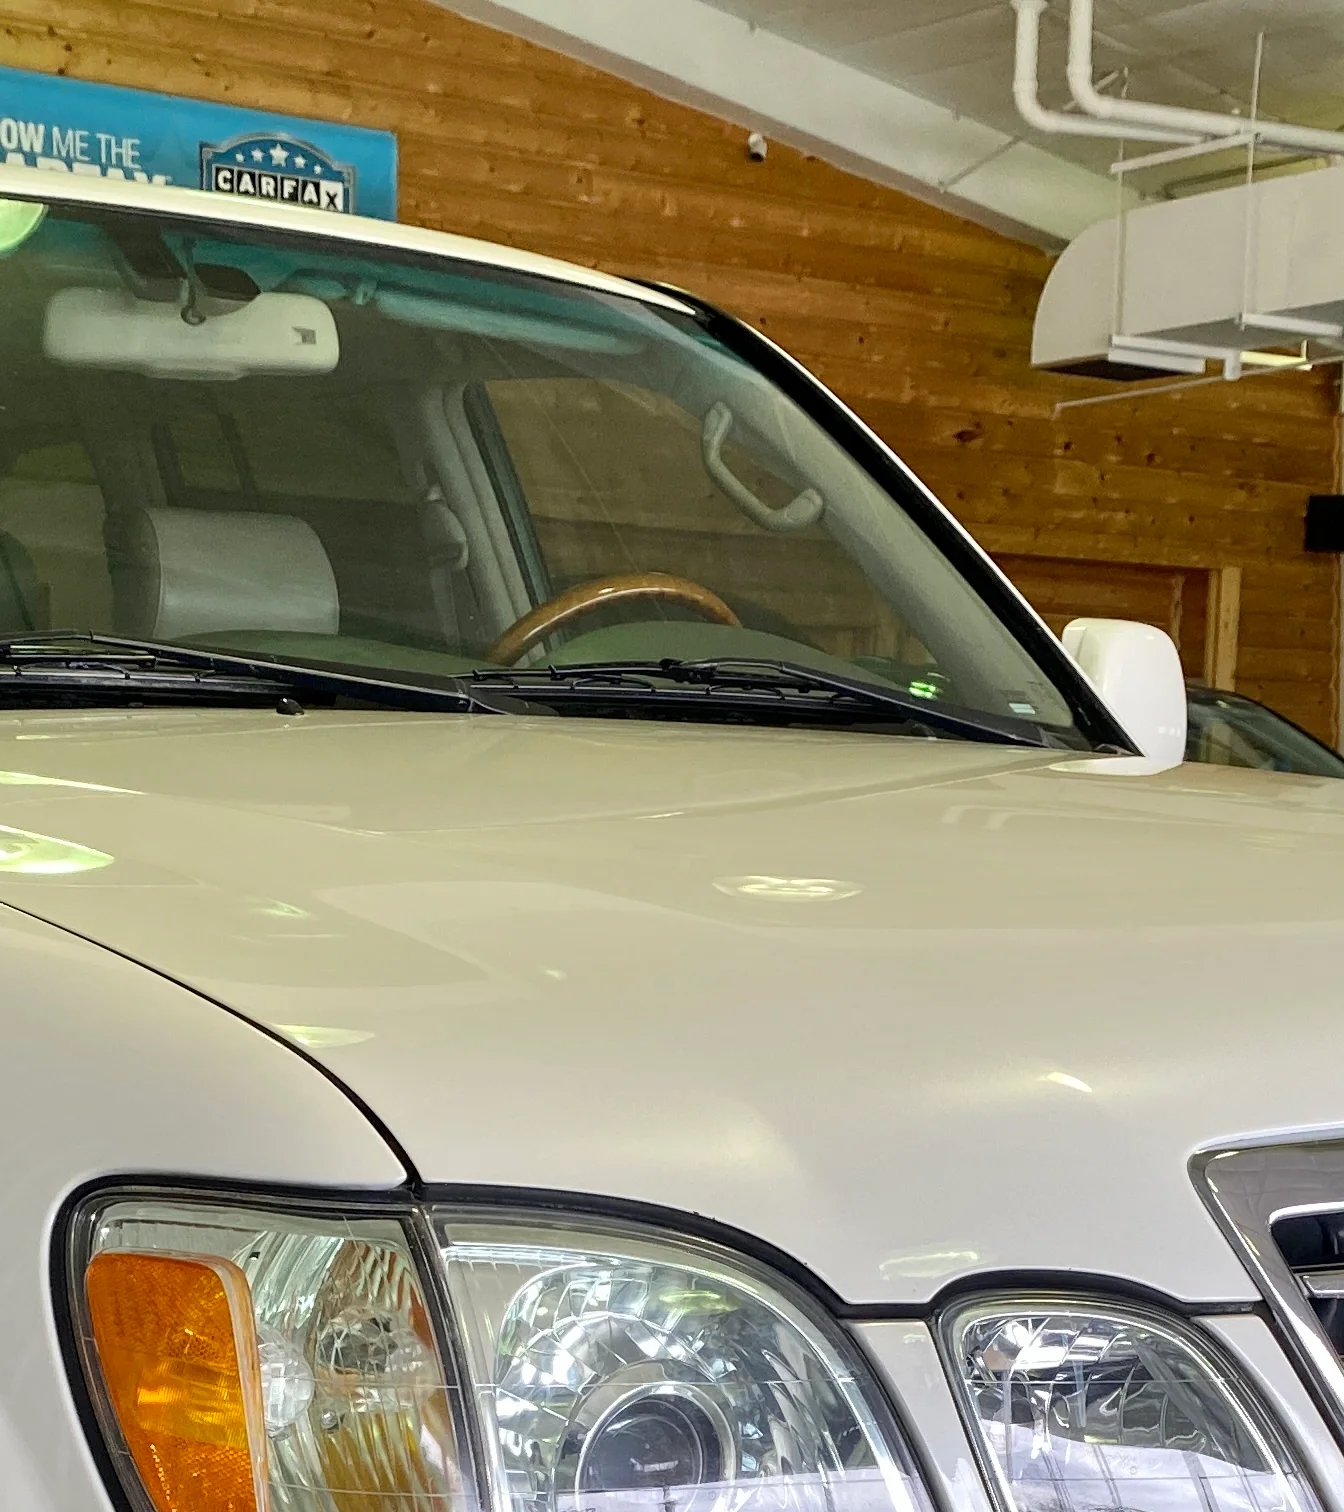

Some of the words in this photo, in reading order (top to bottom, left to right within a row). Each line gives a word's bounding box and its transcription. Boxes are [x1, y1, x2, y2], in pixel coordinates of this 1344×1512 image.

[52, 126, 91, 161] ME
[96, 132, 142, 169] THE
[217, 169, 338, 210] CARFAX
